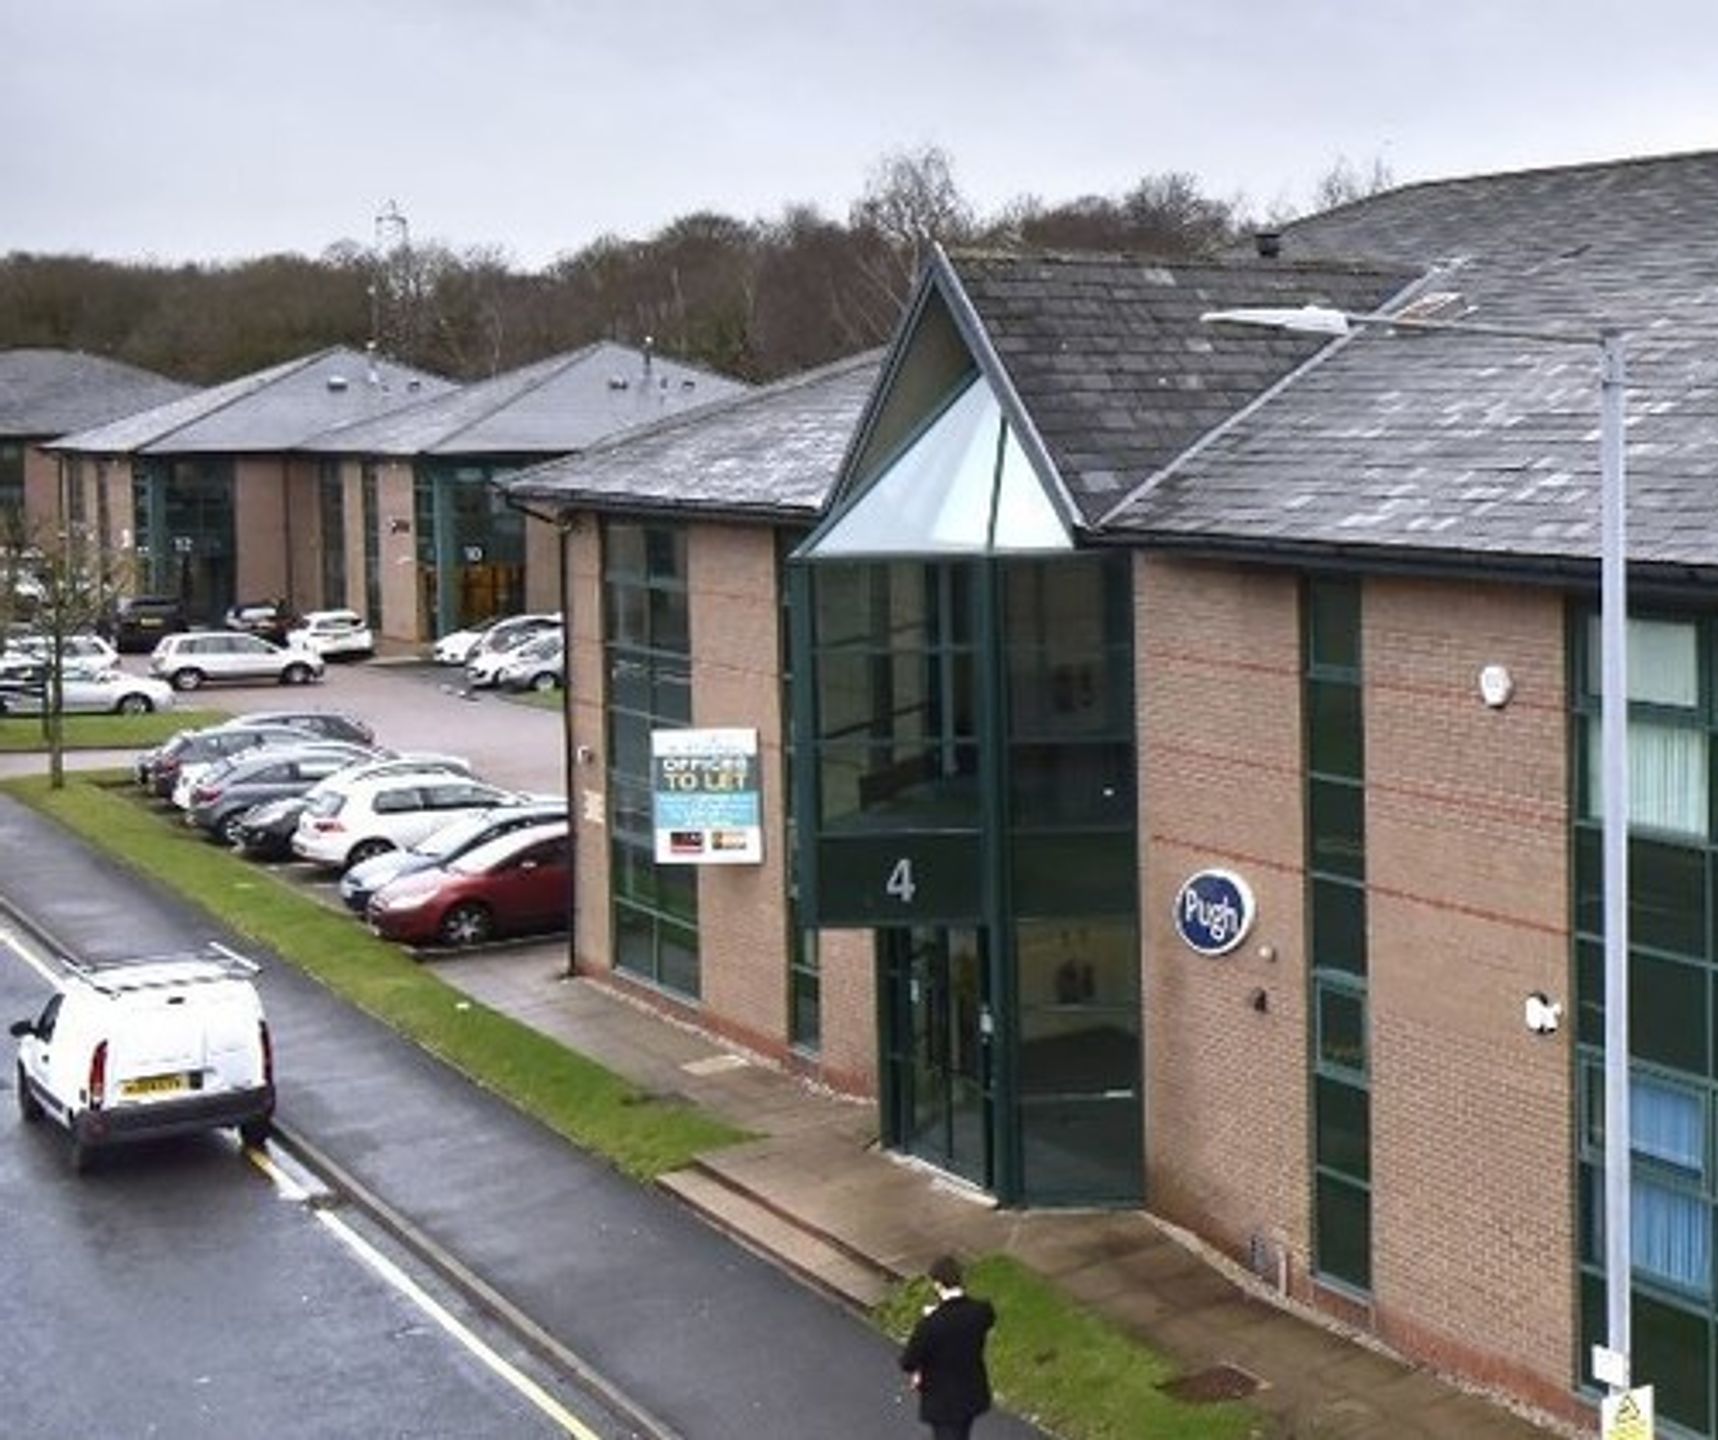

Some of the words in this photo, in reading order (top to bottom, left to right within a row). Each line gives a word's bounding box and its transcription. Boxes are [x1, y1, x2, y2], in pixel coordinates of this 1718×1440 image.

[663, 757, 748, 772] OFFICES
[664, 772, 698, 790] TO
[704, 772, 747, 791] LET
[886, 858, 916, 902] 4
[1185, 889, 1239, 941] Pugh
